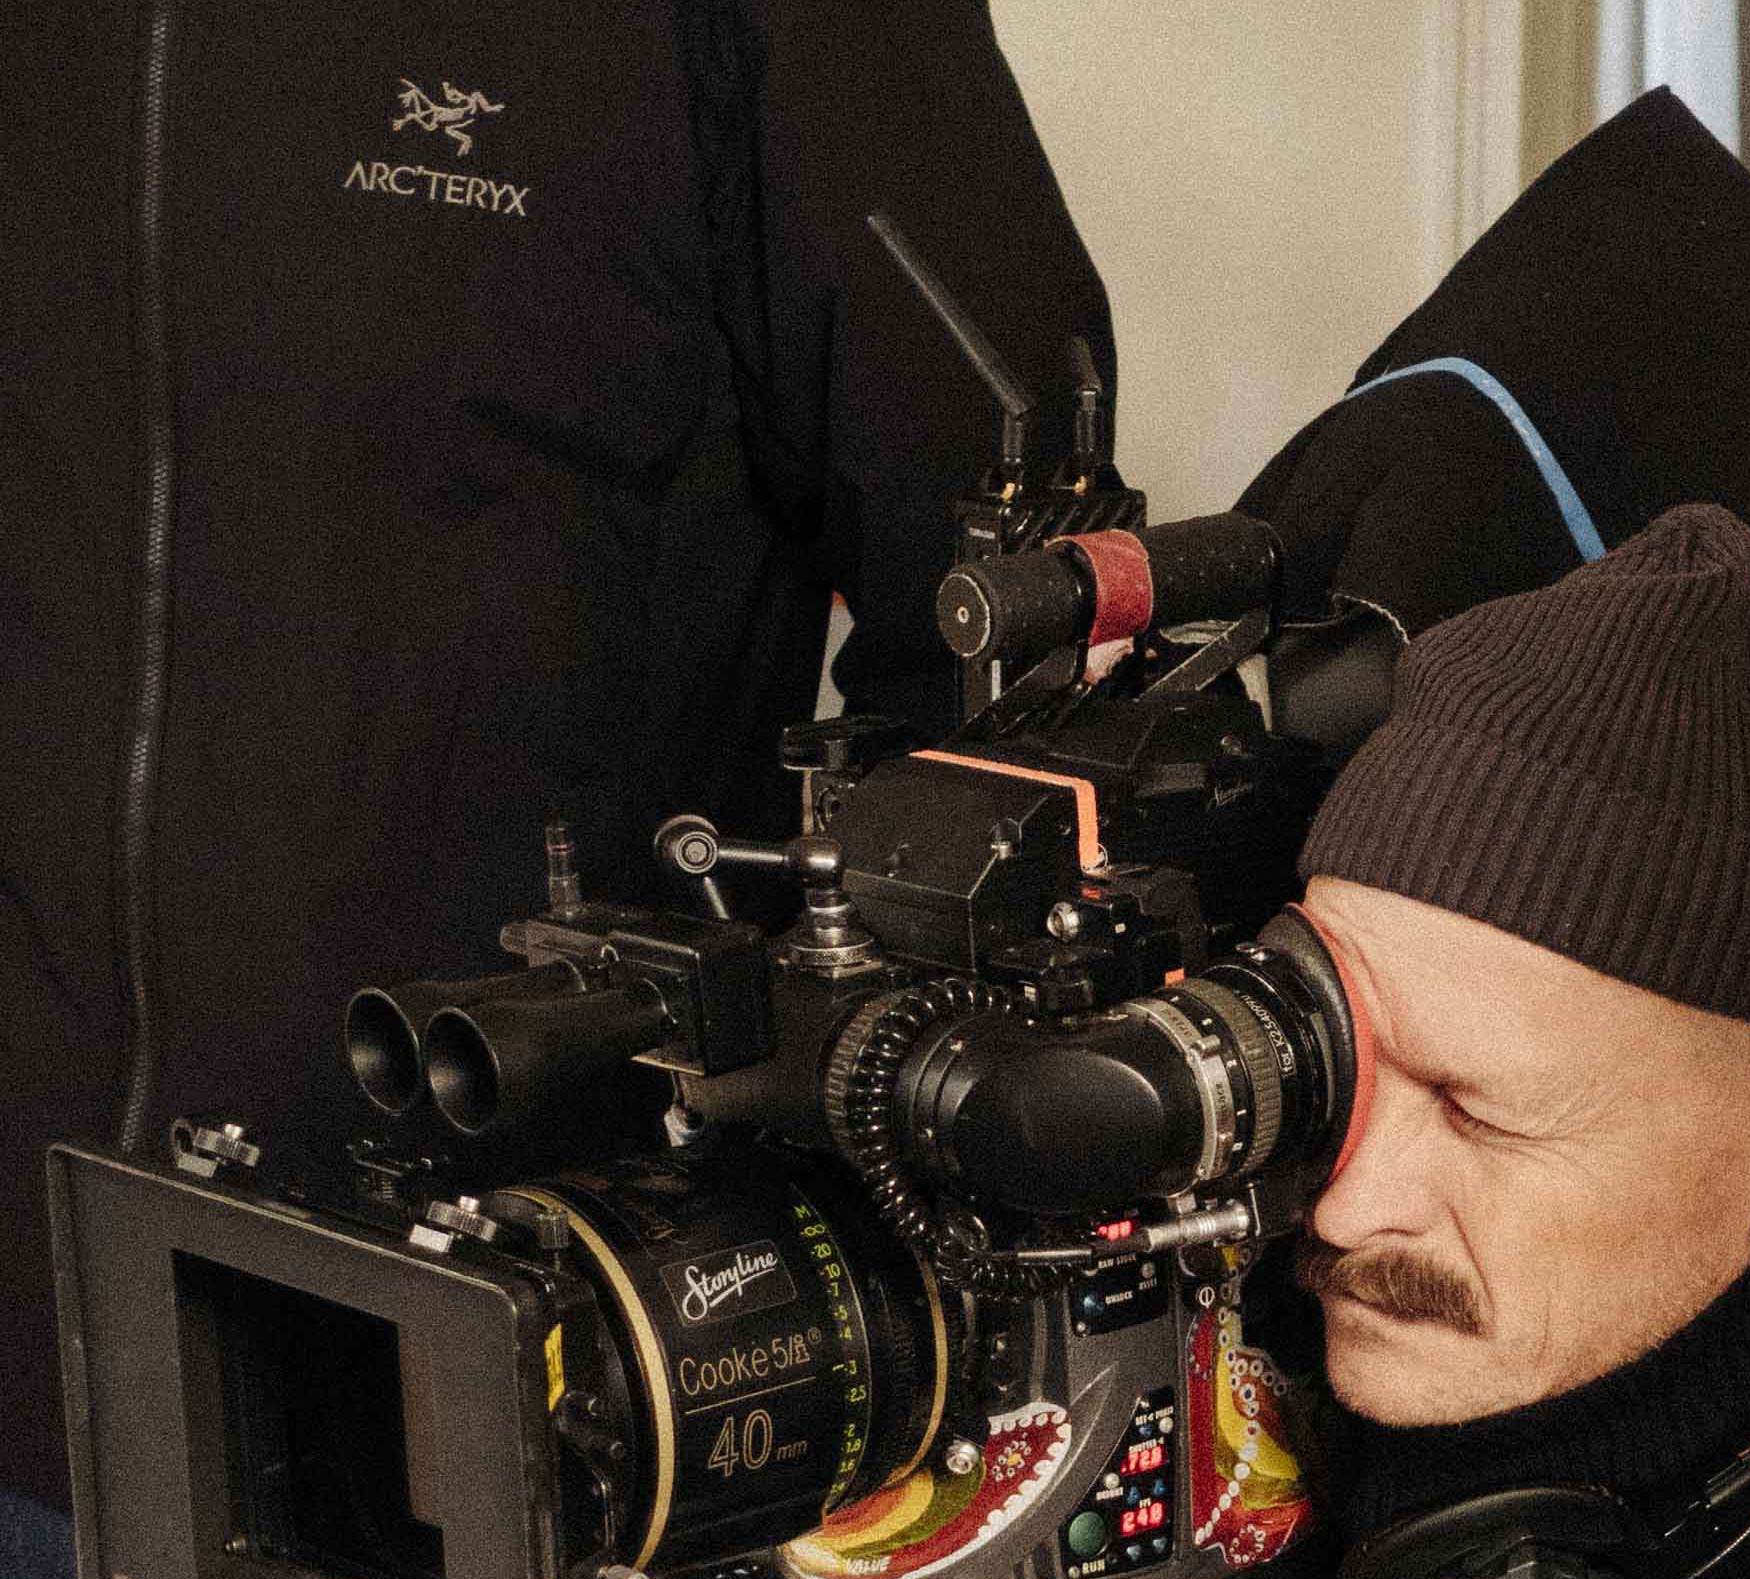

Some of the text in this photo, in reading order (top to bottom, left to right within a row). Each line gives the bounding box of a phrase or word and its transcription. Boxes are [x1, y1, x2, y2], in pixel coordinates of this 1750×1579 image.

[344, 160, 531, 217] ARC'TERYX
[682, 1251, 779, 1321] Storyline
[824, 1262, 841, 1279] 10
[679, 1347, 770, 1396] Cooke
[707, 1408, 809, 1478] 40 mm
[1081, 1559, 1106, 1575] RUN
